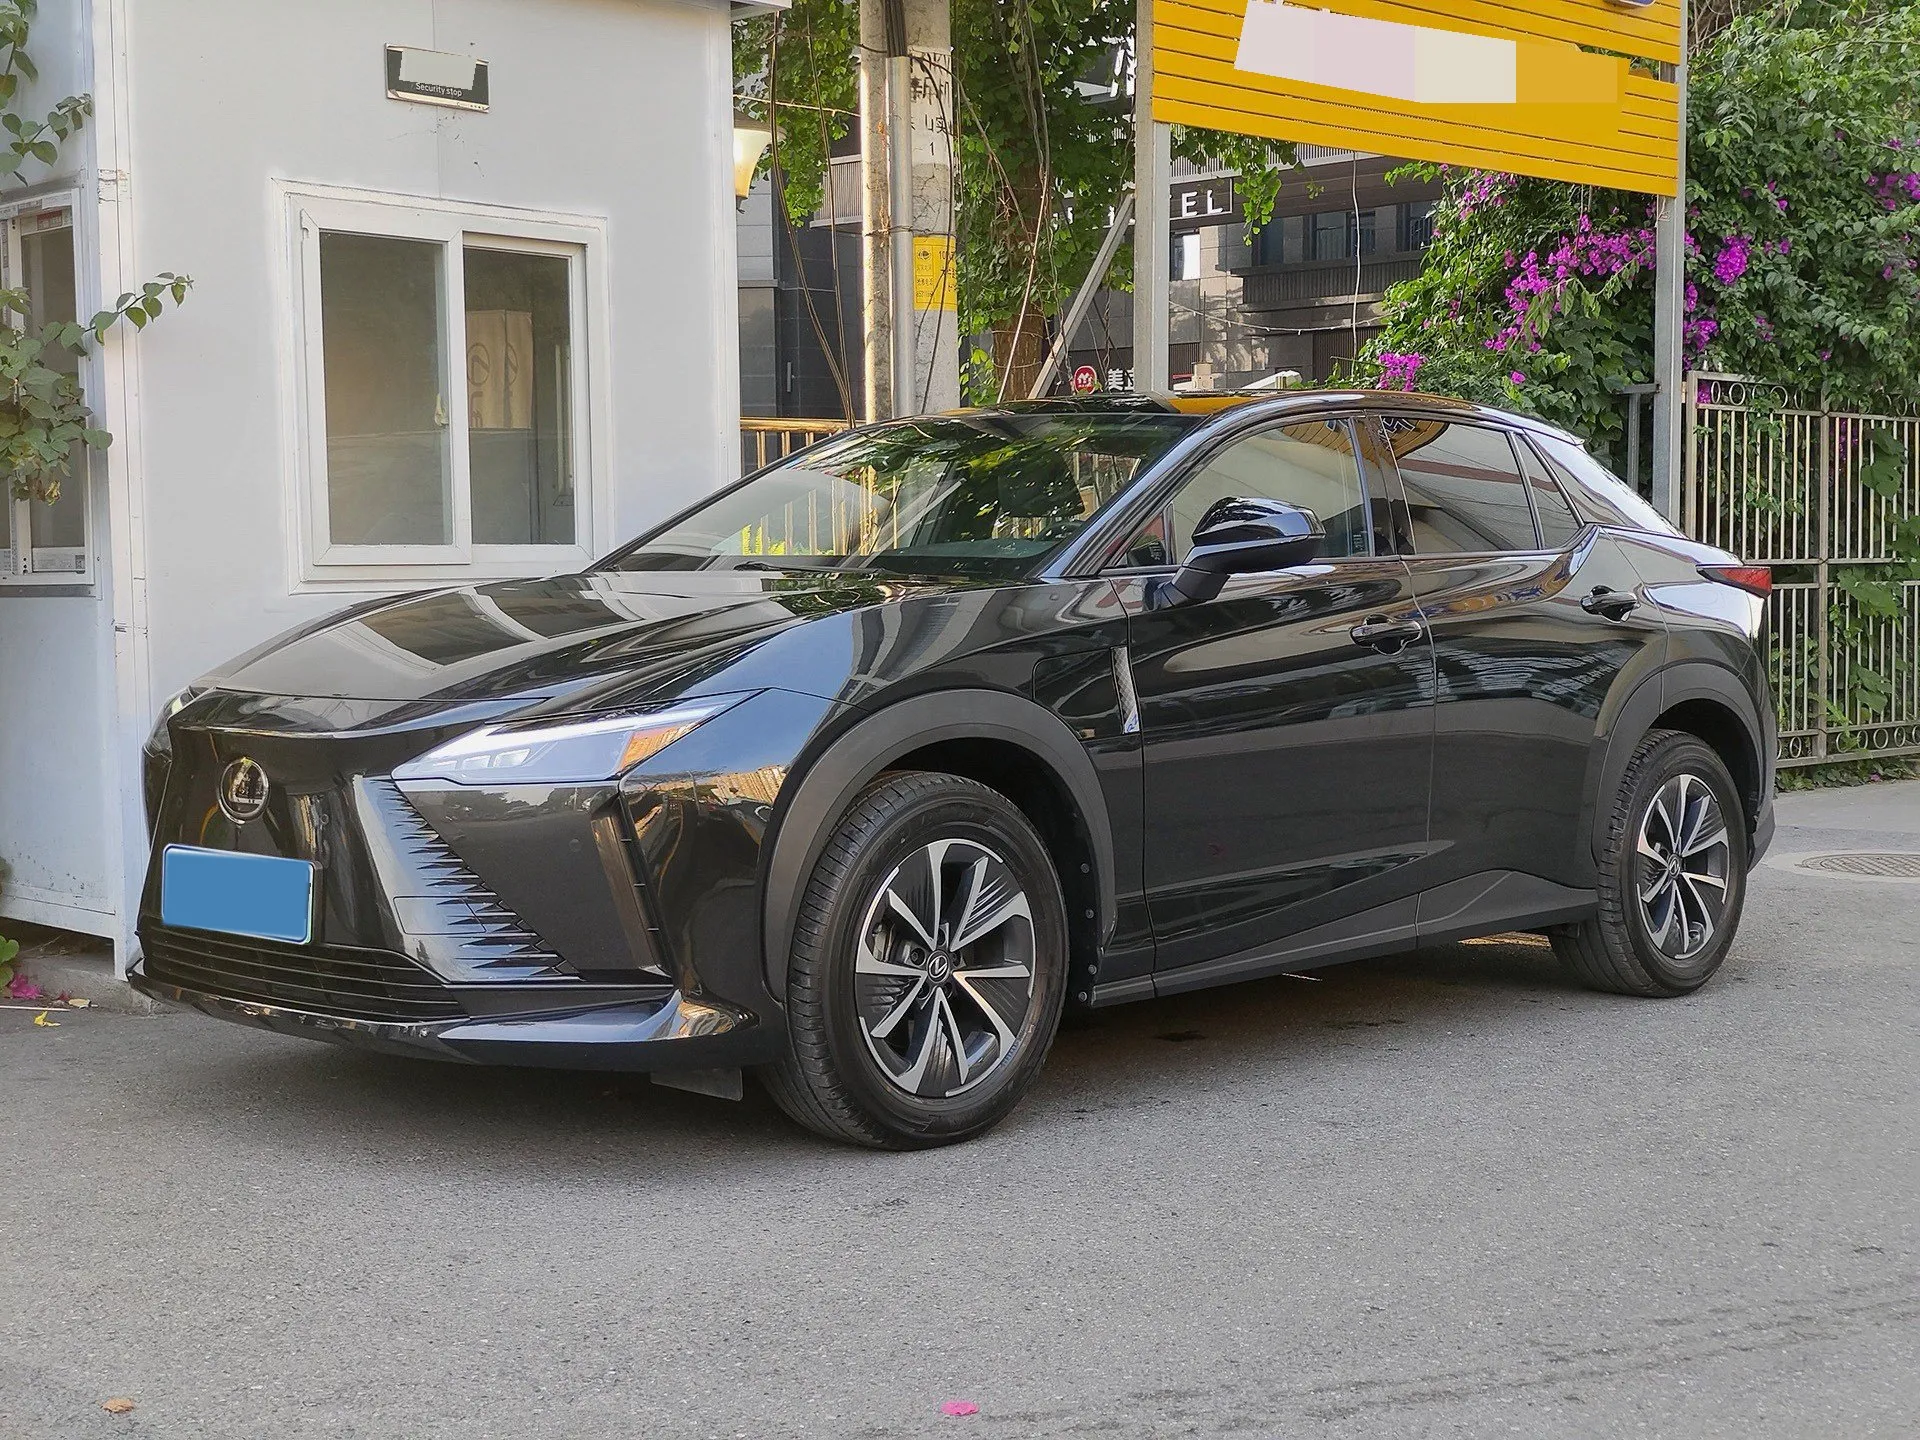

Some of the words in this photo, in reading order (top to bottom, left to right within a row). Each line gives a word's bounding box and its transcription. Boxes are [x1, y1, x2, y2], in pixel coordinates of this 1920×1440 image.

[415, 82, 446, 96] Security
[446, 87, 463, 98] stop
[1180, 189, 1224, 218] EL
